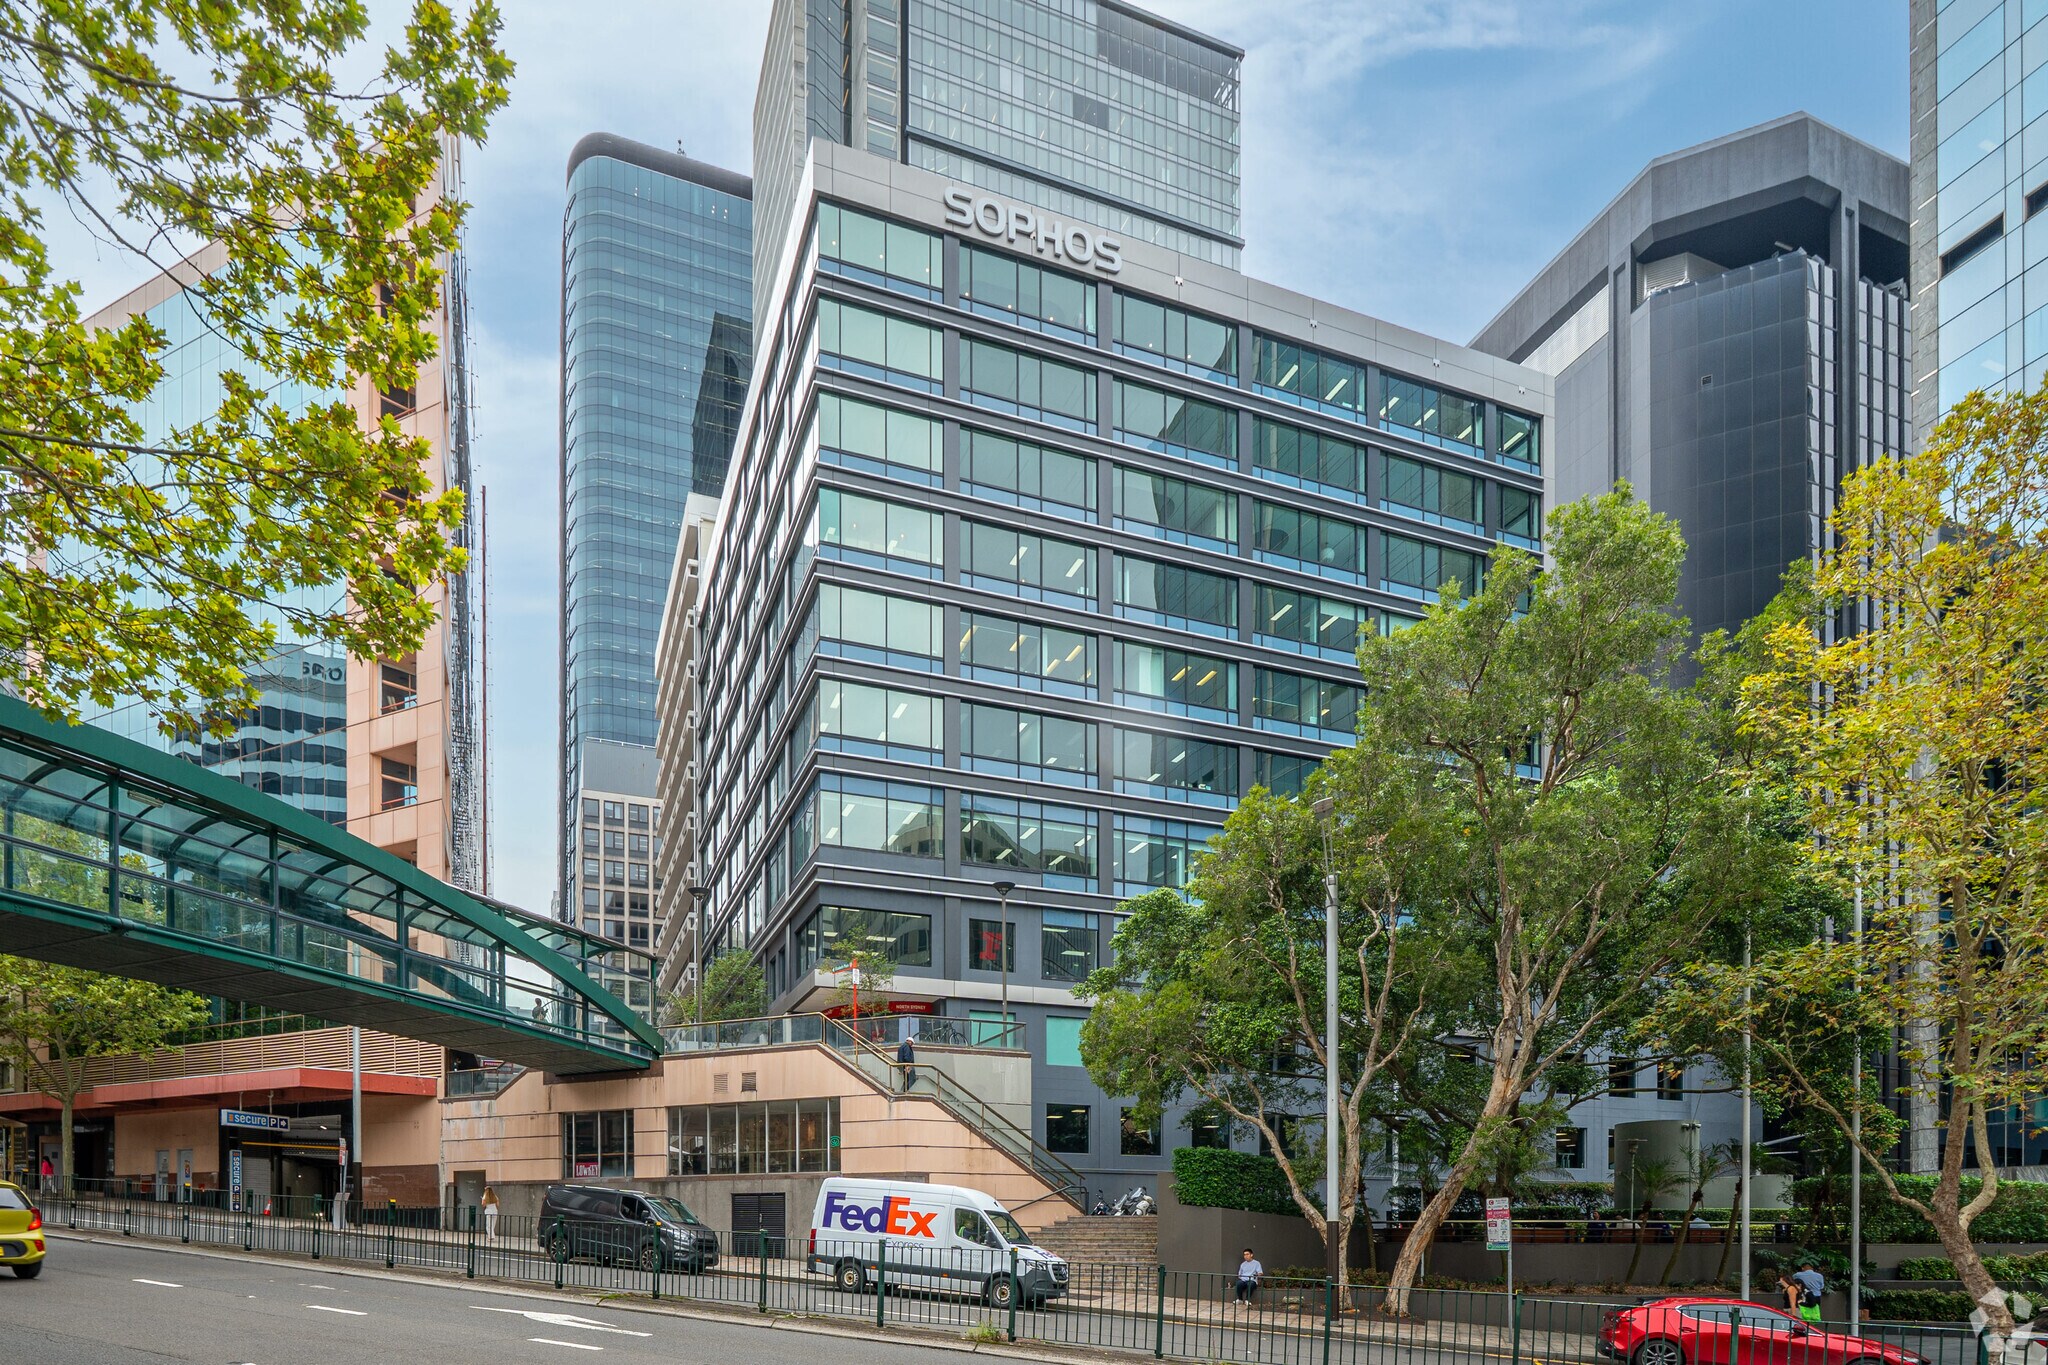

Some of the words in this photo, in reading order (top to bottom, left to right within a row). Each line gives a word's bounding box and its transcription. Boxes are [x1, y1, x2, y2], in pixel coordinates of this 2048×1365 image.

[943, 186, 1122, 274] SOPHOS
[234, 1114, 267, 1126] secure
[270, 1118, 277, 1127] P
[822, 1191, 939, 1239] FedEx
[885, 1237, 924, 1252] Express
